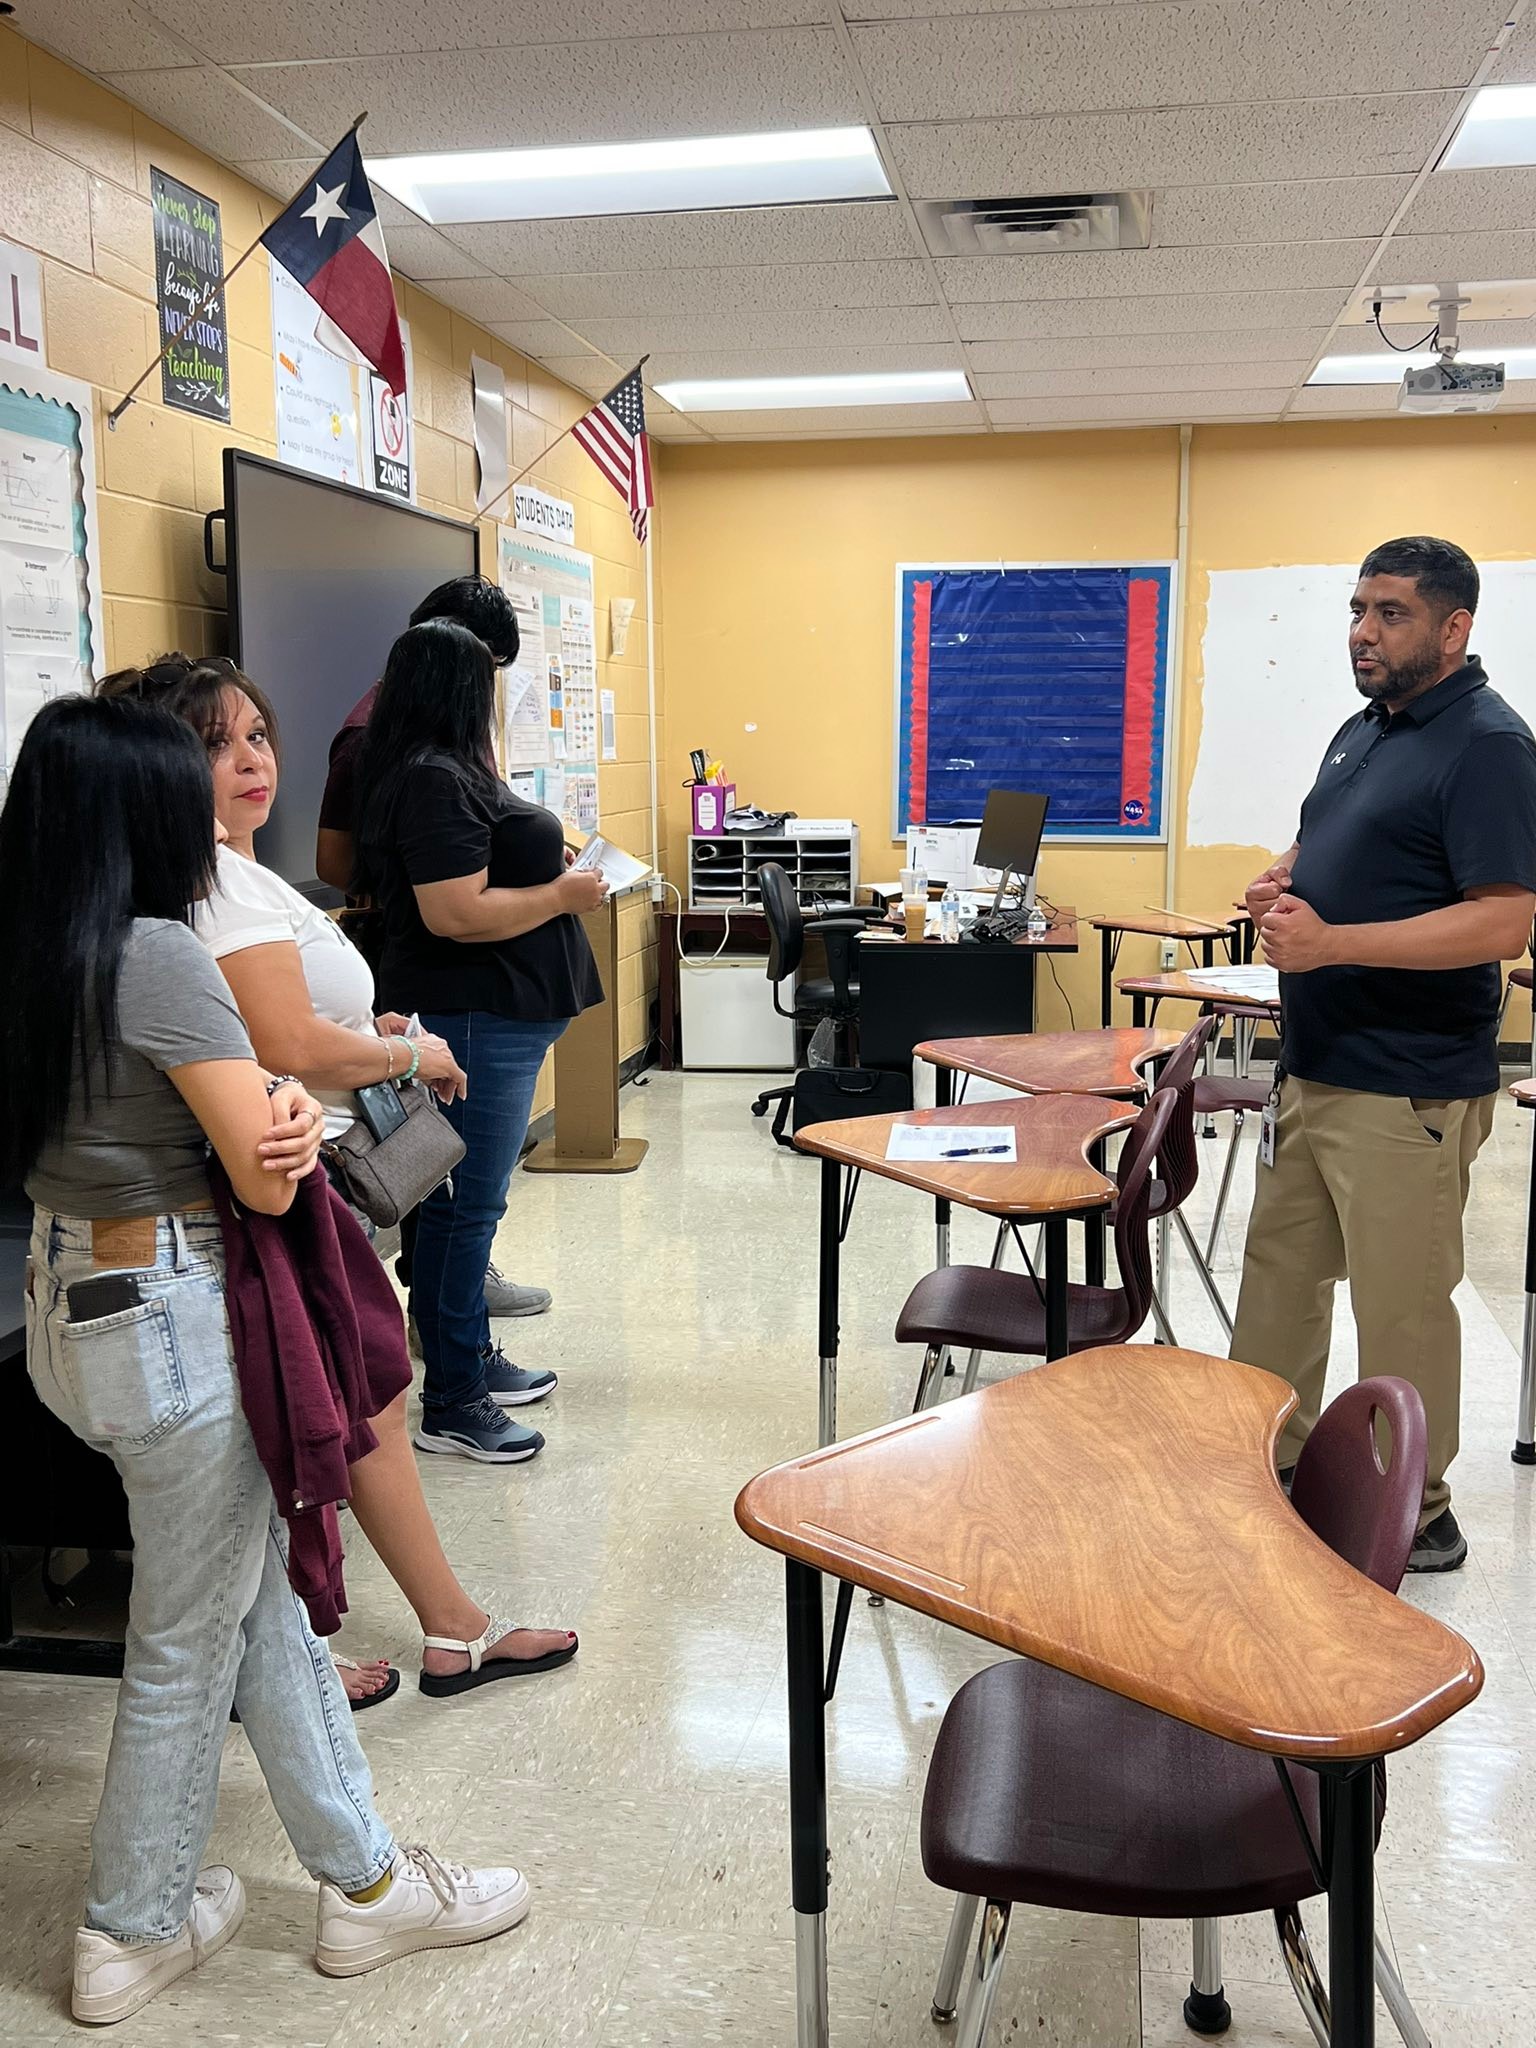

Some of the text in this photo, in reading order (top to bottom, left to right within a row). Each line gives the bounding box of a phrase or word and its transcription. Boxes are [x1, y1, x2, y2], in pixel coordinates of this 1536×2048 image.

[156, 192, 216, 243] never stop
[161, 217, 219, 278] LEARNING
[164, 261, 220, 321] because life
[164, 304, 223, 354] NEVER STOPS
[165, 345, 224, 397] teaching
[379, 460, 408, 492] ZONE
[515, 495, 574, 532] STUDENTS DATA
[1124, 805, 1144, 816] NASA
